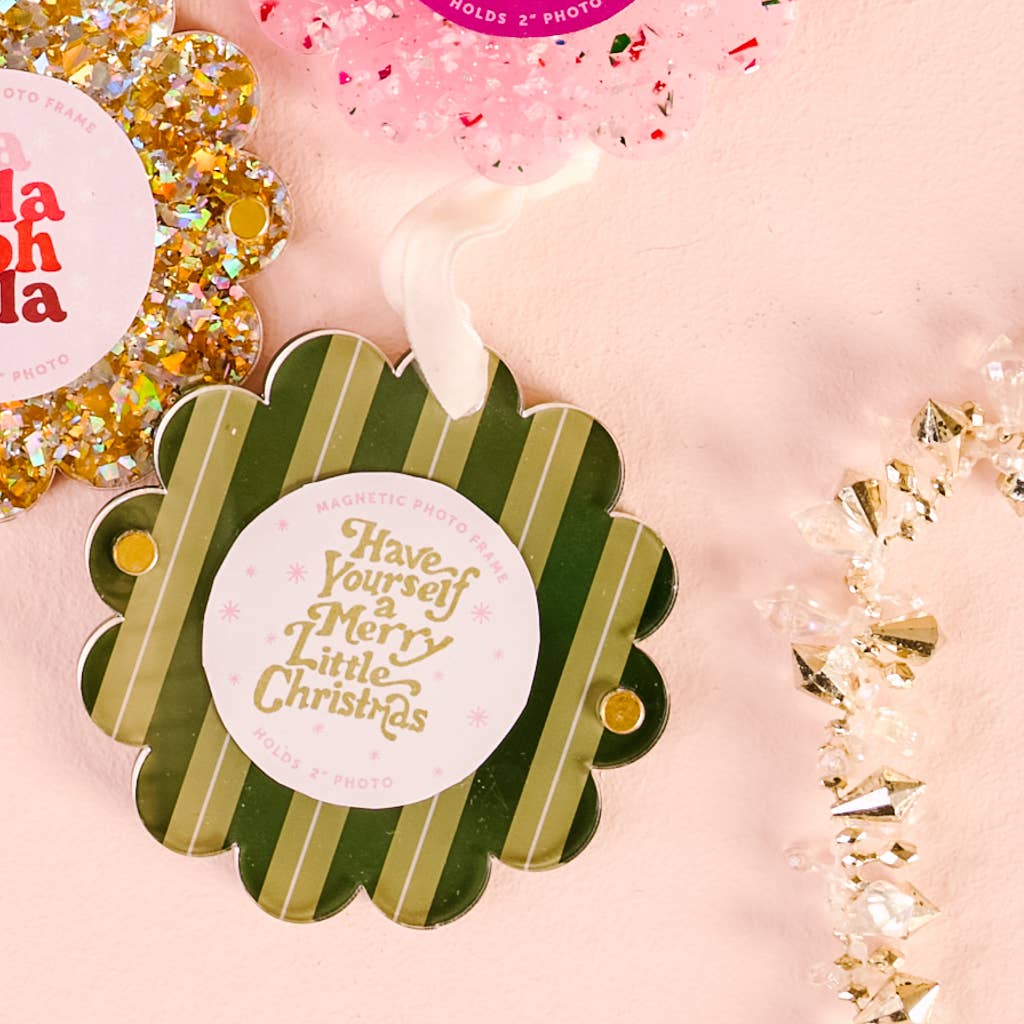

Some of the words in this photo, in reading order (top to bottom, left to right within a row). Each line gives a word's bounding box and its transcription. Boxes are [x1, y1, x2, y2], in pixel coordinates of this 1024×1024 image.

[45, 98, 96, 134] FRAME
[13, 354, 69, 382] PHOTO
[316, 493, 407, 514] MAGNETIC
[413, 499, 469, 533] PHOTO
[469, 535, 508, 583] FRAME
[341, 517, 458, 576] Have
[317, 550, 480, 622] Yourself
[374, 596, 397, 618] a
[284, 621, 421, 696] Little
[307, 602, 453, 667] Merry
[253, 665, 429, 741] Christmas
[253, 728, 301, 769] HOLDS
[334, 775, 393, 789] PHOTO
